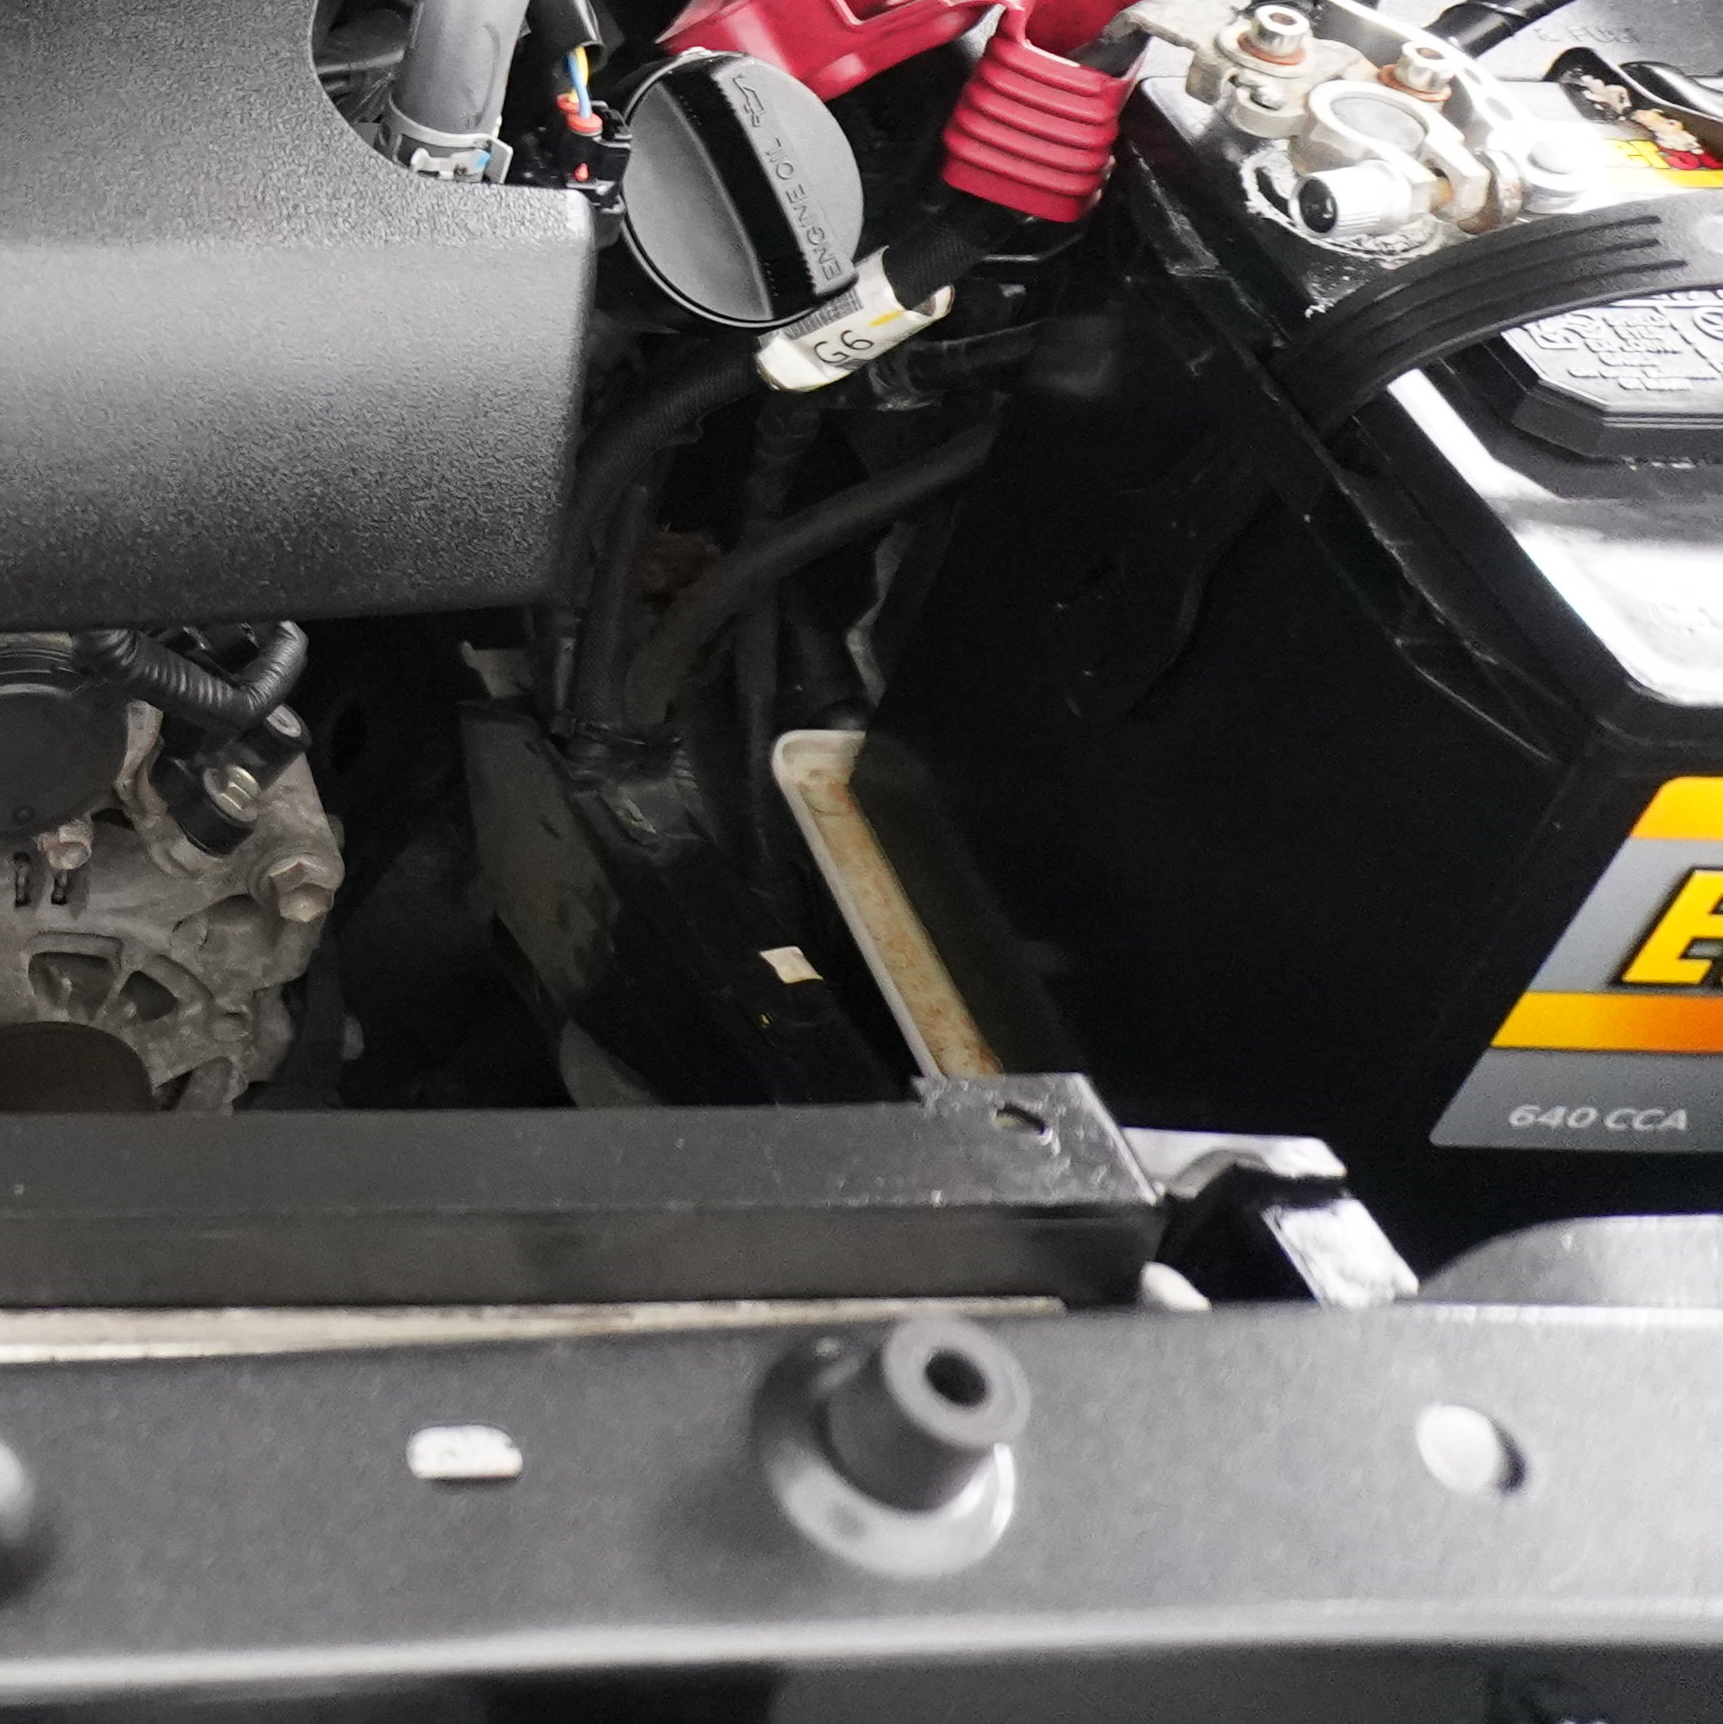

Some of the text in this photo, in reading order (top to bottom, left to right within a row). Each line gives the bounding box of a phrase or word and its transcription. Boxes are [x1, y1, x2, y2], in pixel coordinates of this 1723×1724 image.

[764, 137, 843, 282] ENGINE OIL
[813, 329, 875, 364] G6
[1508, 1104, 1688, 1132] 640 CCA
